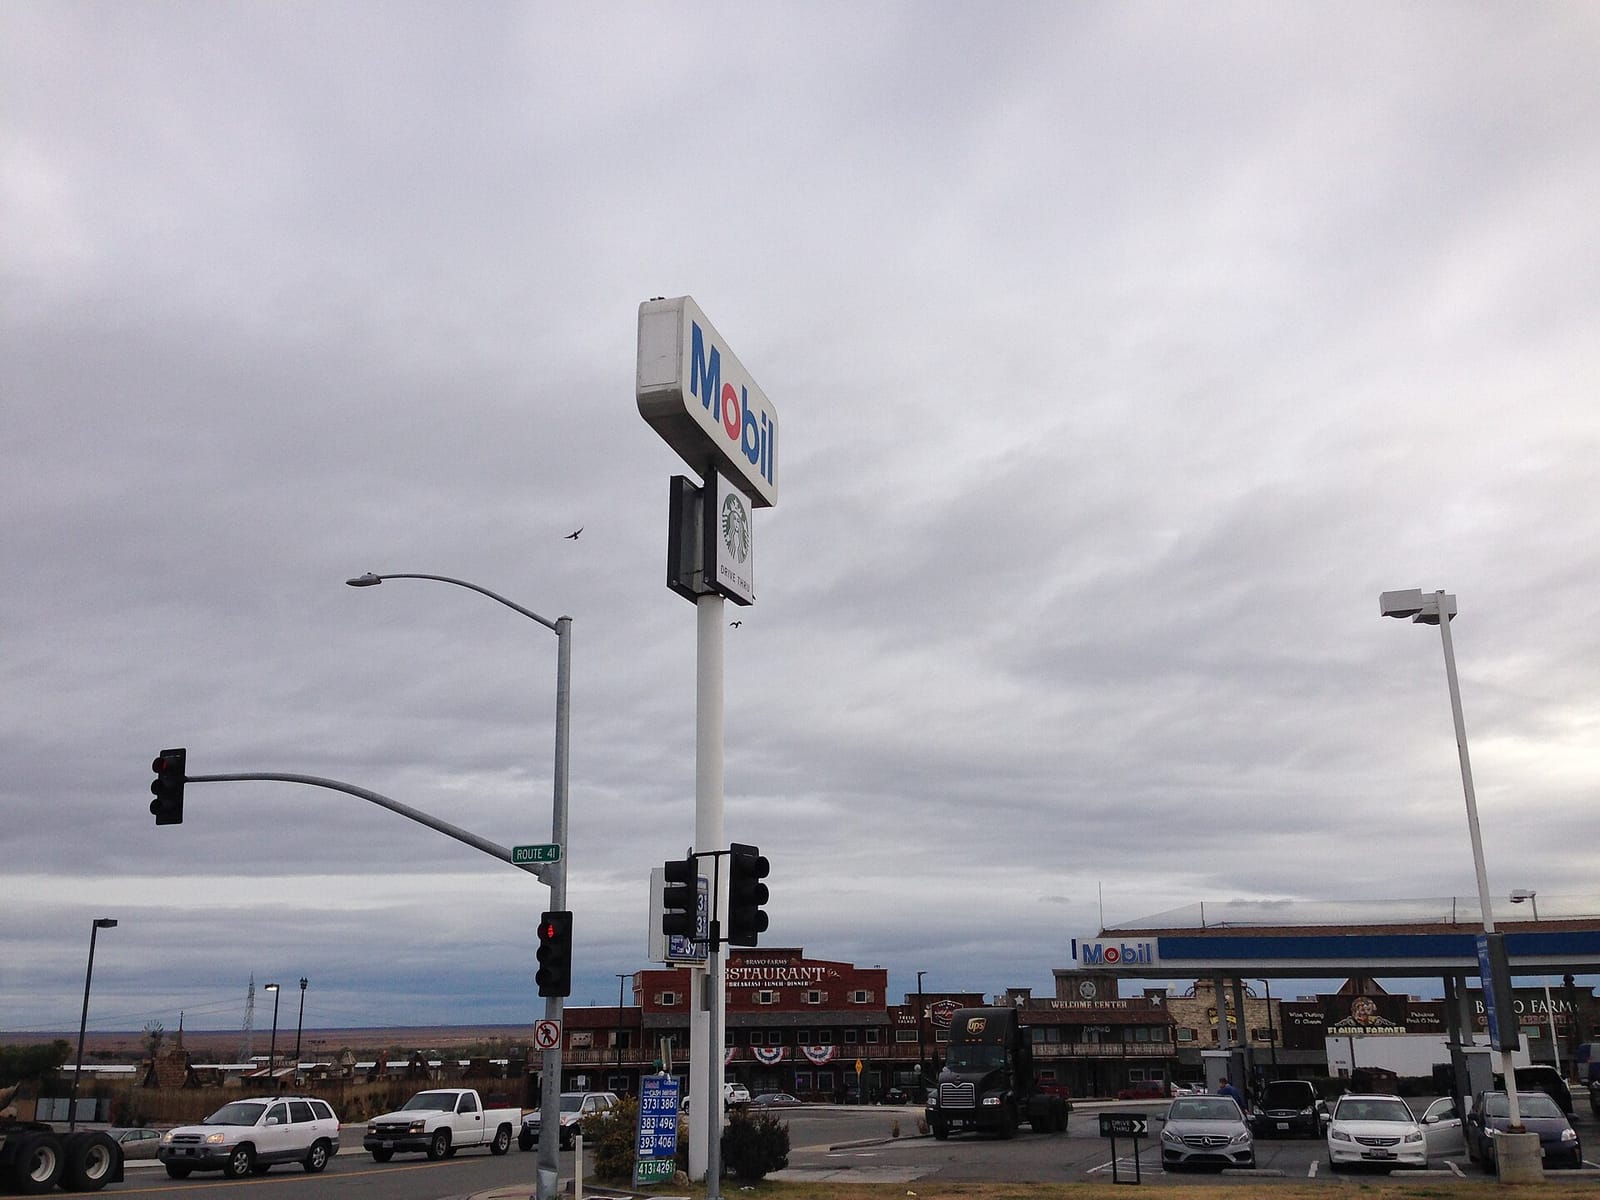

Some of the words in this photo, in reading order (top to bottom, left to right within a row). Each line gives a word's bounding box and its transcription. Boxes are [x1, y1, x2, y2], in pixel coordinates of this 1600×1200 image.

[690, 319, 774, 486] Mobil
[720, 565, 736, 584] DRIVE
[737, 576, 750, 593] THRU
[516, 848, 543, 861] ROUTE
[546, 847, 556, 859] 41
[1082, 943, 1153, 965] Mobil
[725, 967, 825, 982] STAURANT
[1050, 1000, 1092, 1009] WELCOME
[1094, 1000, 1128, 1009] CENTER
[968, 1020, 985, 1034] ups
[1327, 1026, 1365, 1034] FLAVOR
[1366, 1026, 1407, 1034] FARMER
[642, 1098, 657, 1110] 373
[660, 1097, 674, 1109] 386
[641, 1117, 656, 1129] 383
[640, 1136, 654, 1149] 393
[638, 1163, 653, 1174] 413
